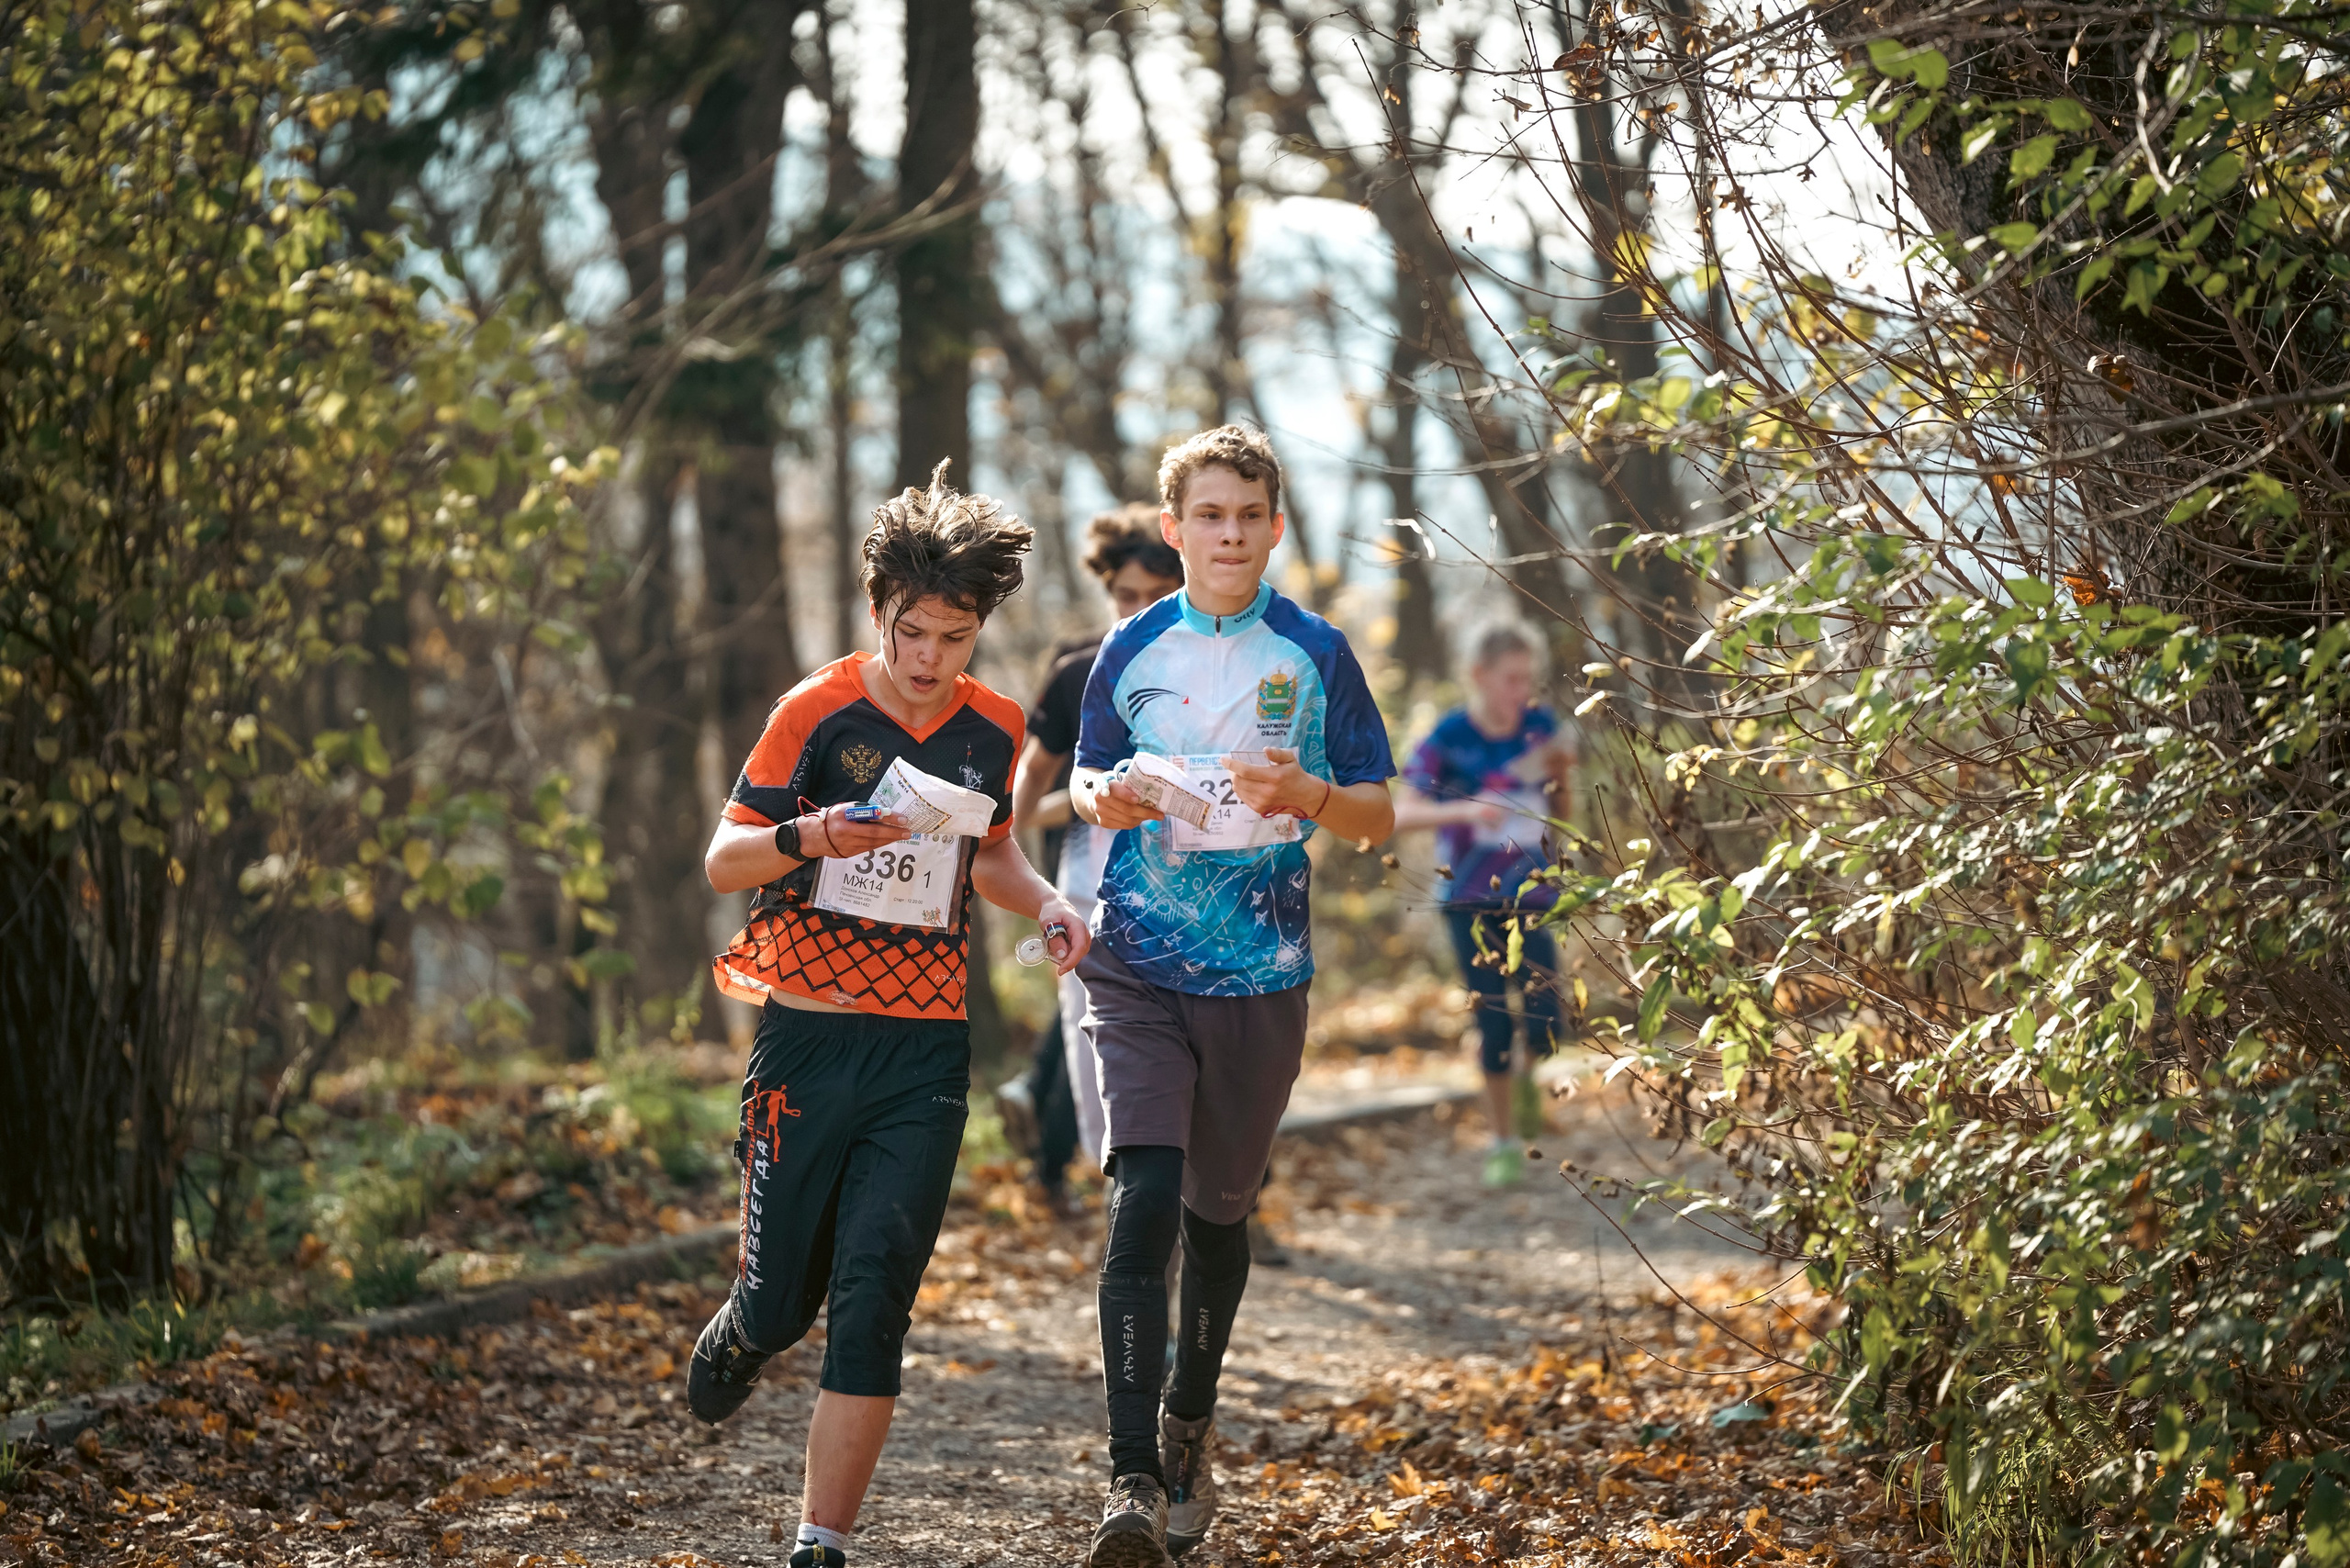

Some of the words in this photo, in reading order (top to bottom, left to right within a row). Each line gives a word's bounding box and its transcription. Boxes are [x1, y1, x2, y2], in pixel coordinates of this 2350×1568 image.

[855, 849, 916, 882] 336
[923, 870, 932, 889] 1
[843, 873, 883, 893] МЖ14
[1197, 1307, 1210, 1350] ARSWEAR
[1124, 1315, 1135, 1383] ARSWEAR
